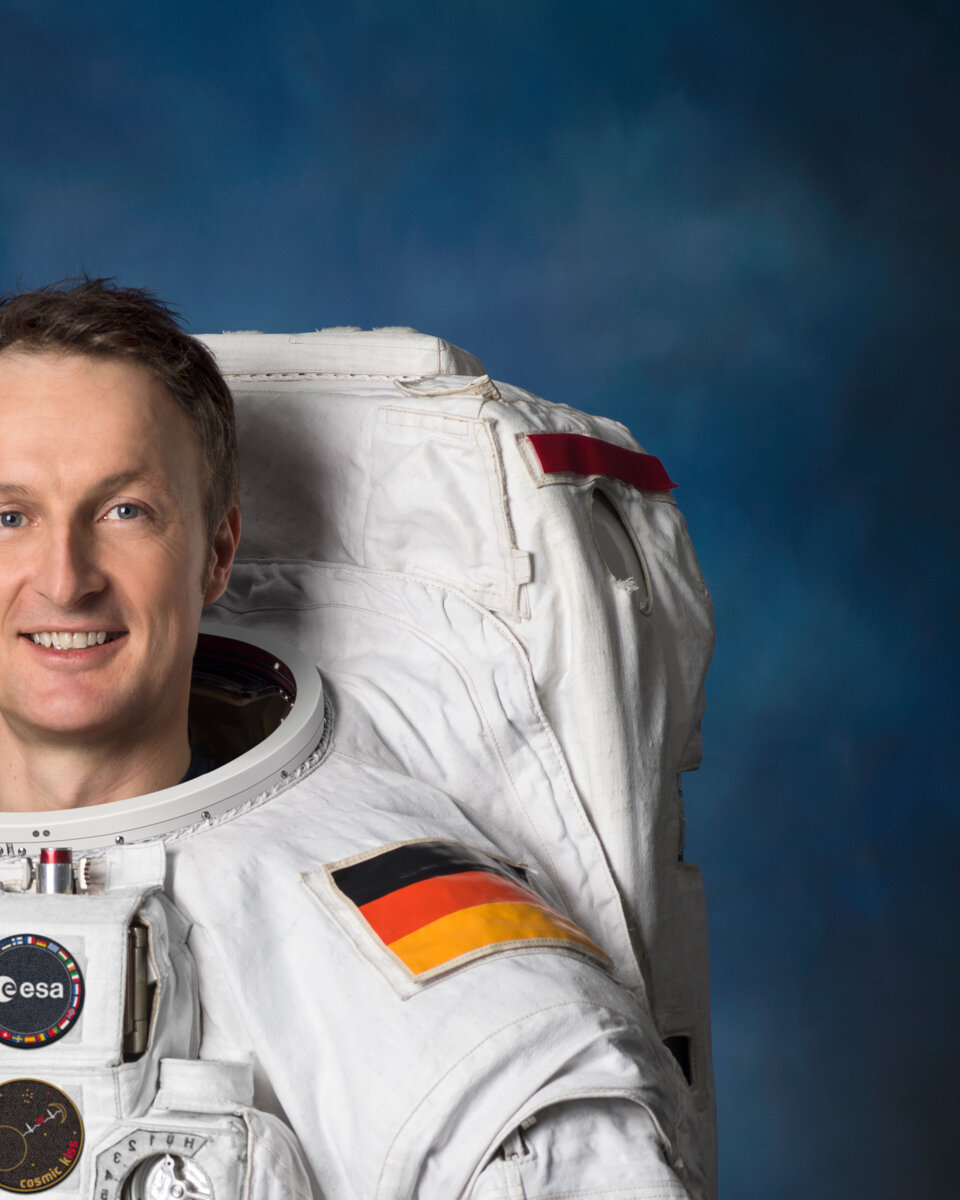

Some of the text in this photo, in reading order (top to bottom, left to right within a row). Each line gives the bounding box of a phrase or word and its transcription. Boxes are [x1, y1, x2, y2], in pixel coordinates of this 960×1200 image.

[19, 981, 64, 999] esa
[19, 1140, 79, 1189] cosmic kiss
